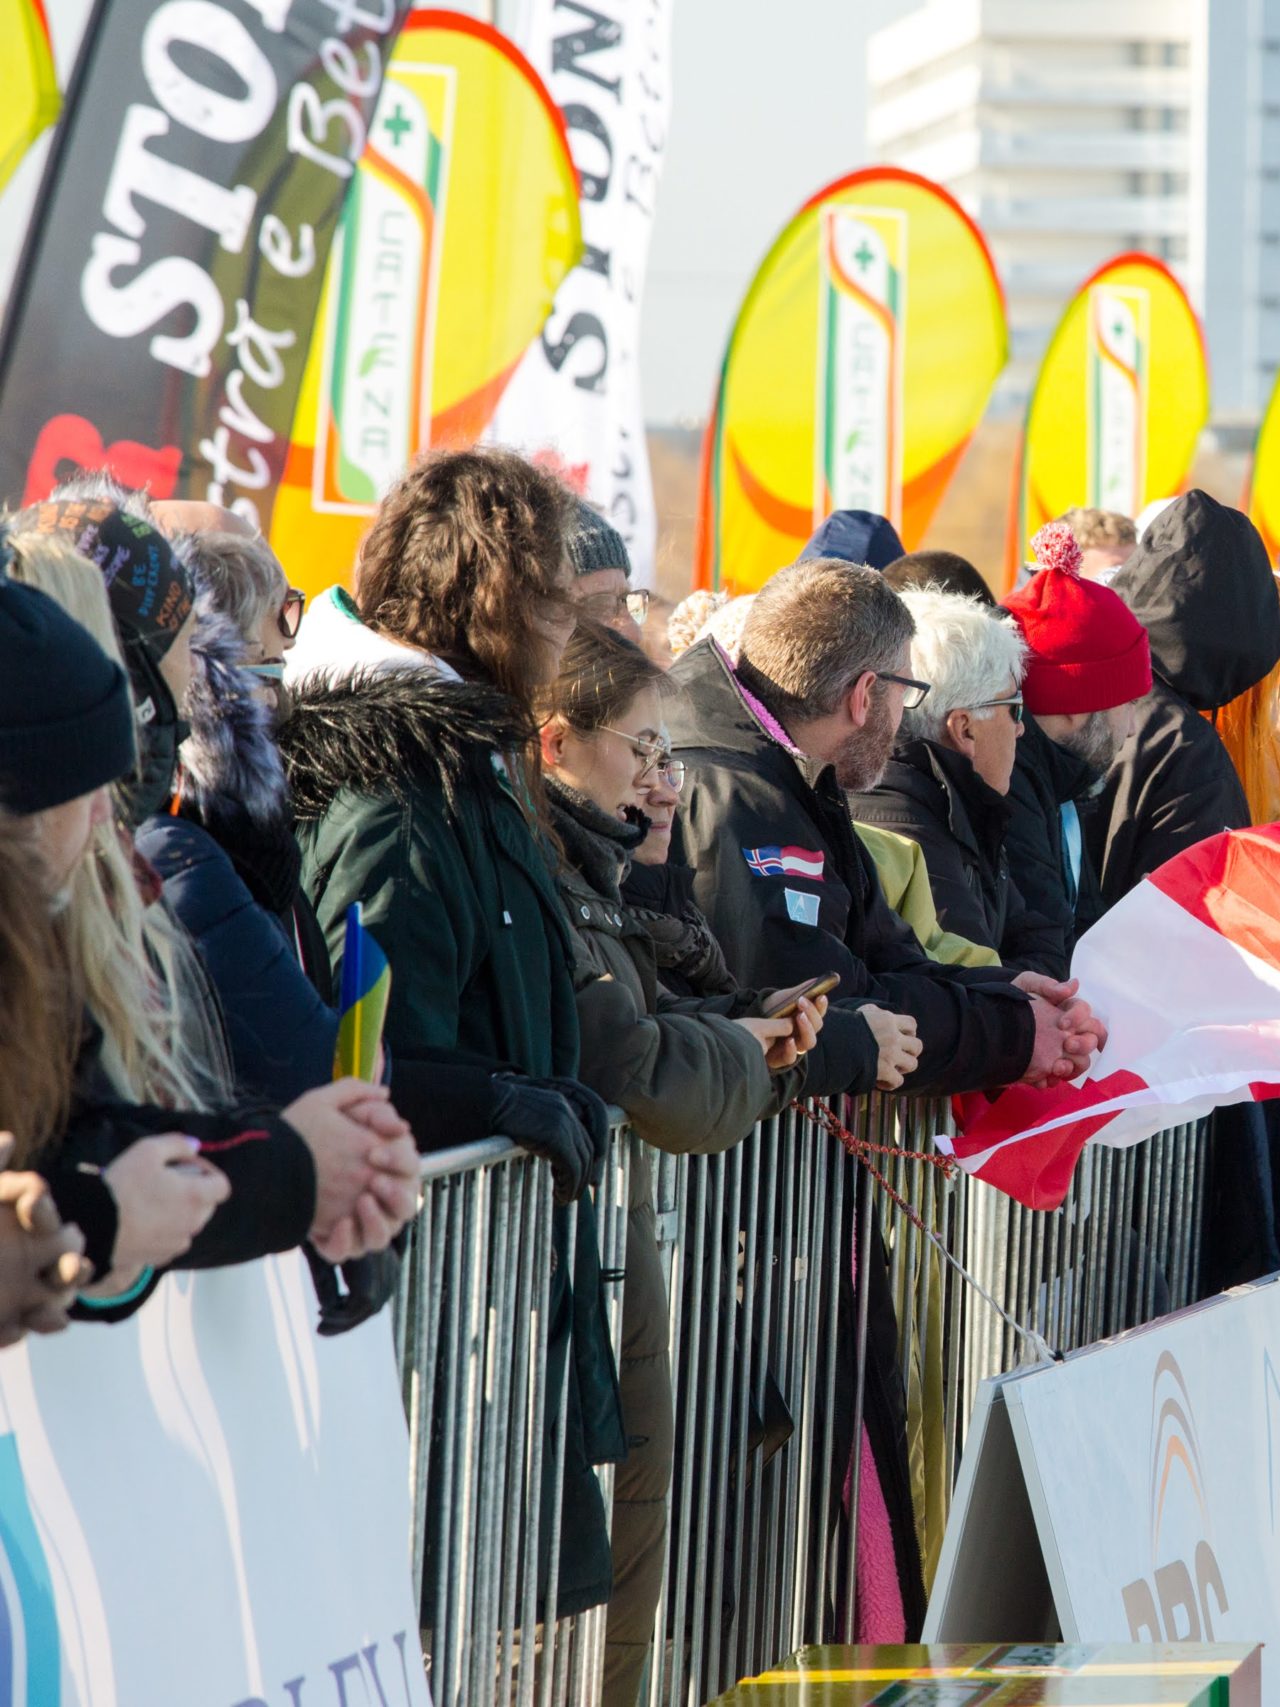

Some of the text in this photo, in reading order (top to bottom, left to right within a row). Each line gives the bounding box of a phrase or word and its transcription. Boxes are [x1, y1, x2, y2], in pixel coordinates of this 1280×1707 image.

[81, 0, 296, 379] STO
[258, 213, 317, 278] e
[360, 208, 406, 462] CATENA
